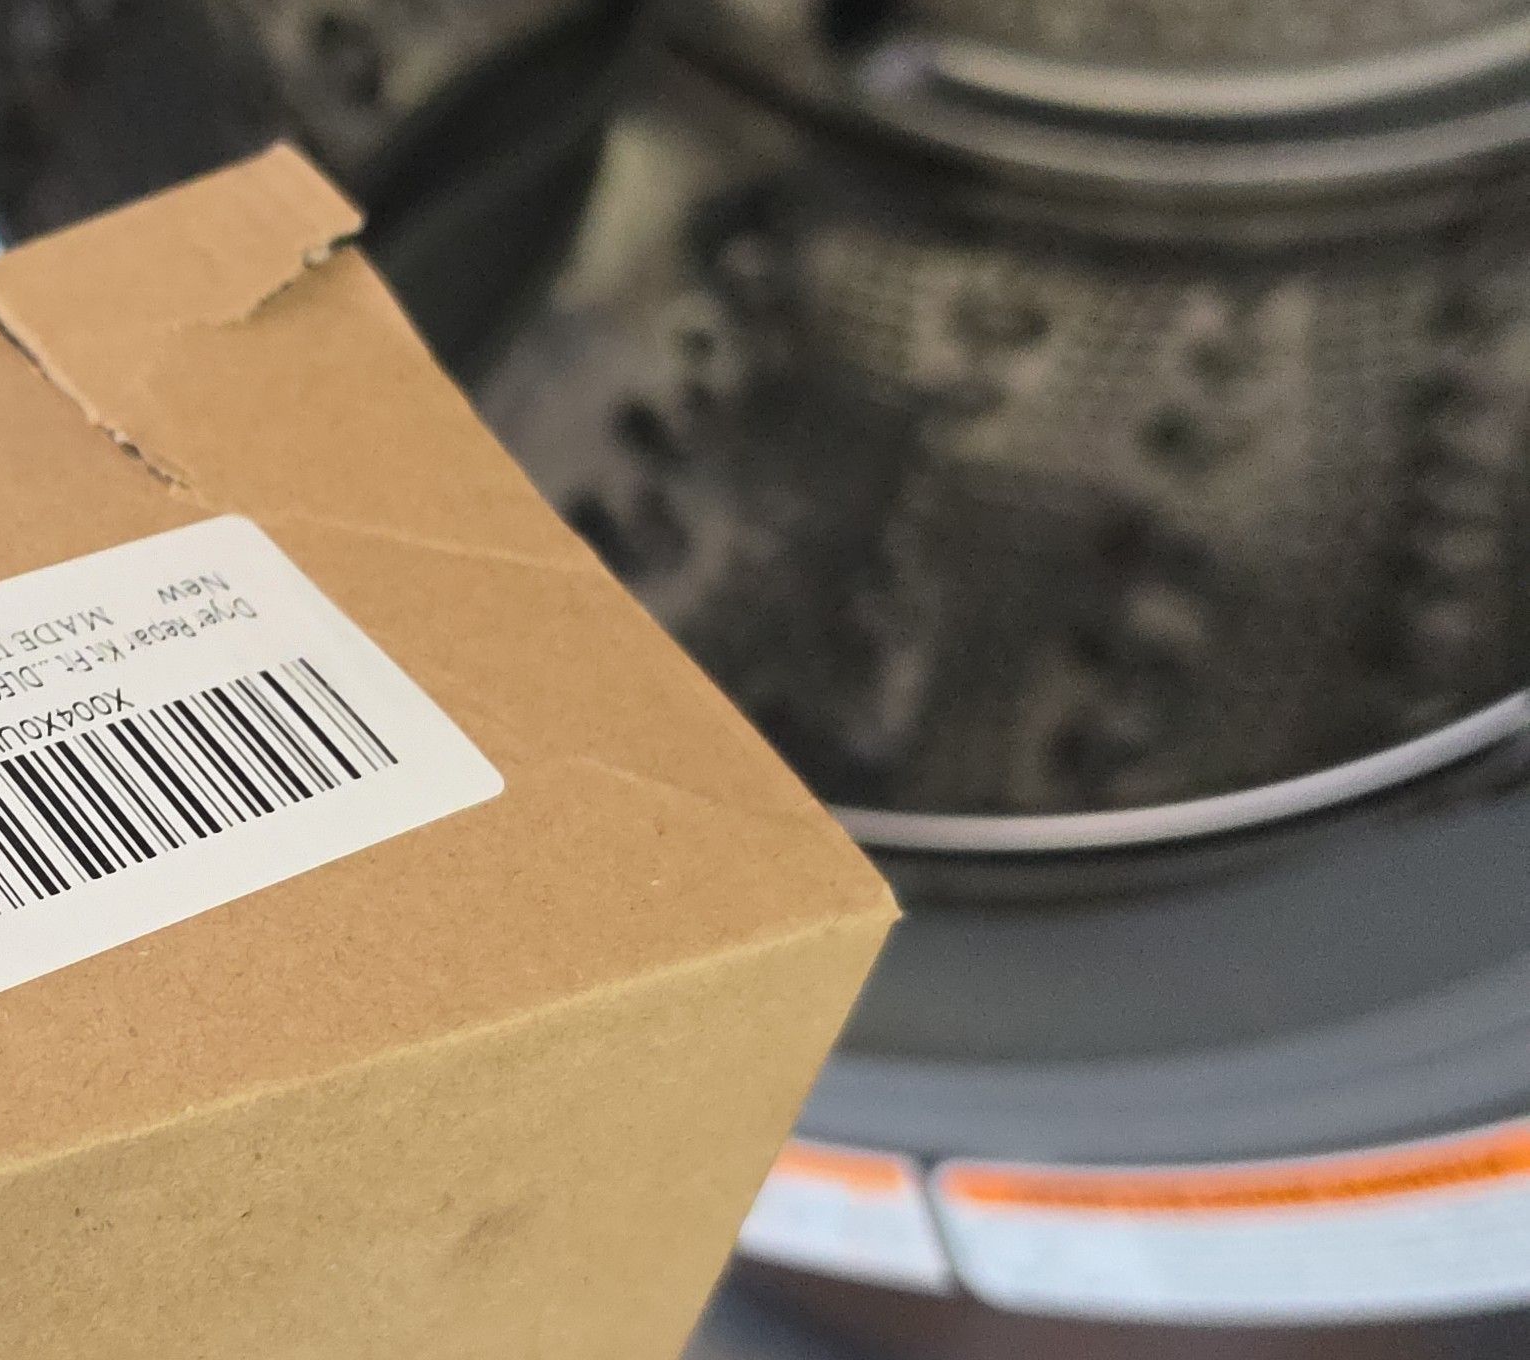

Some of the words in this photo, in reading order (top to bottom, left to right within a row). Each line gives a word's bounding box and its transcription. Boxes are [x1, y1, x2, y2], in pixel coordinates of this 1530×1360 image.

[157, 572, 230, 604] New
[198, 597, 258, 628] Dryer
[11, 606, 115, 652] MADE
